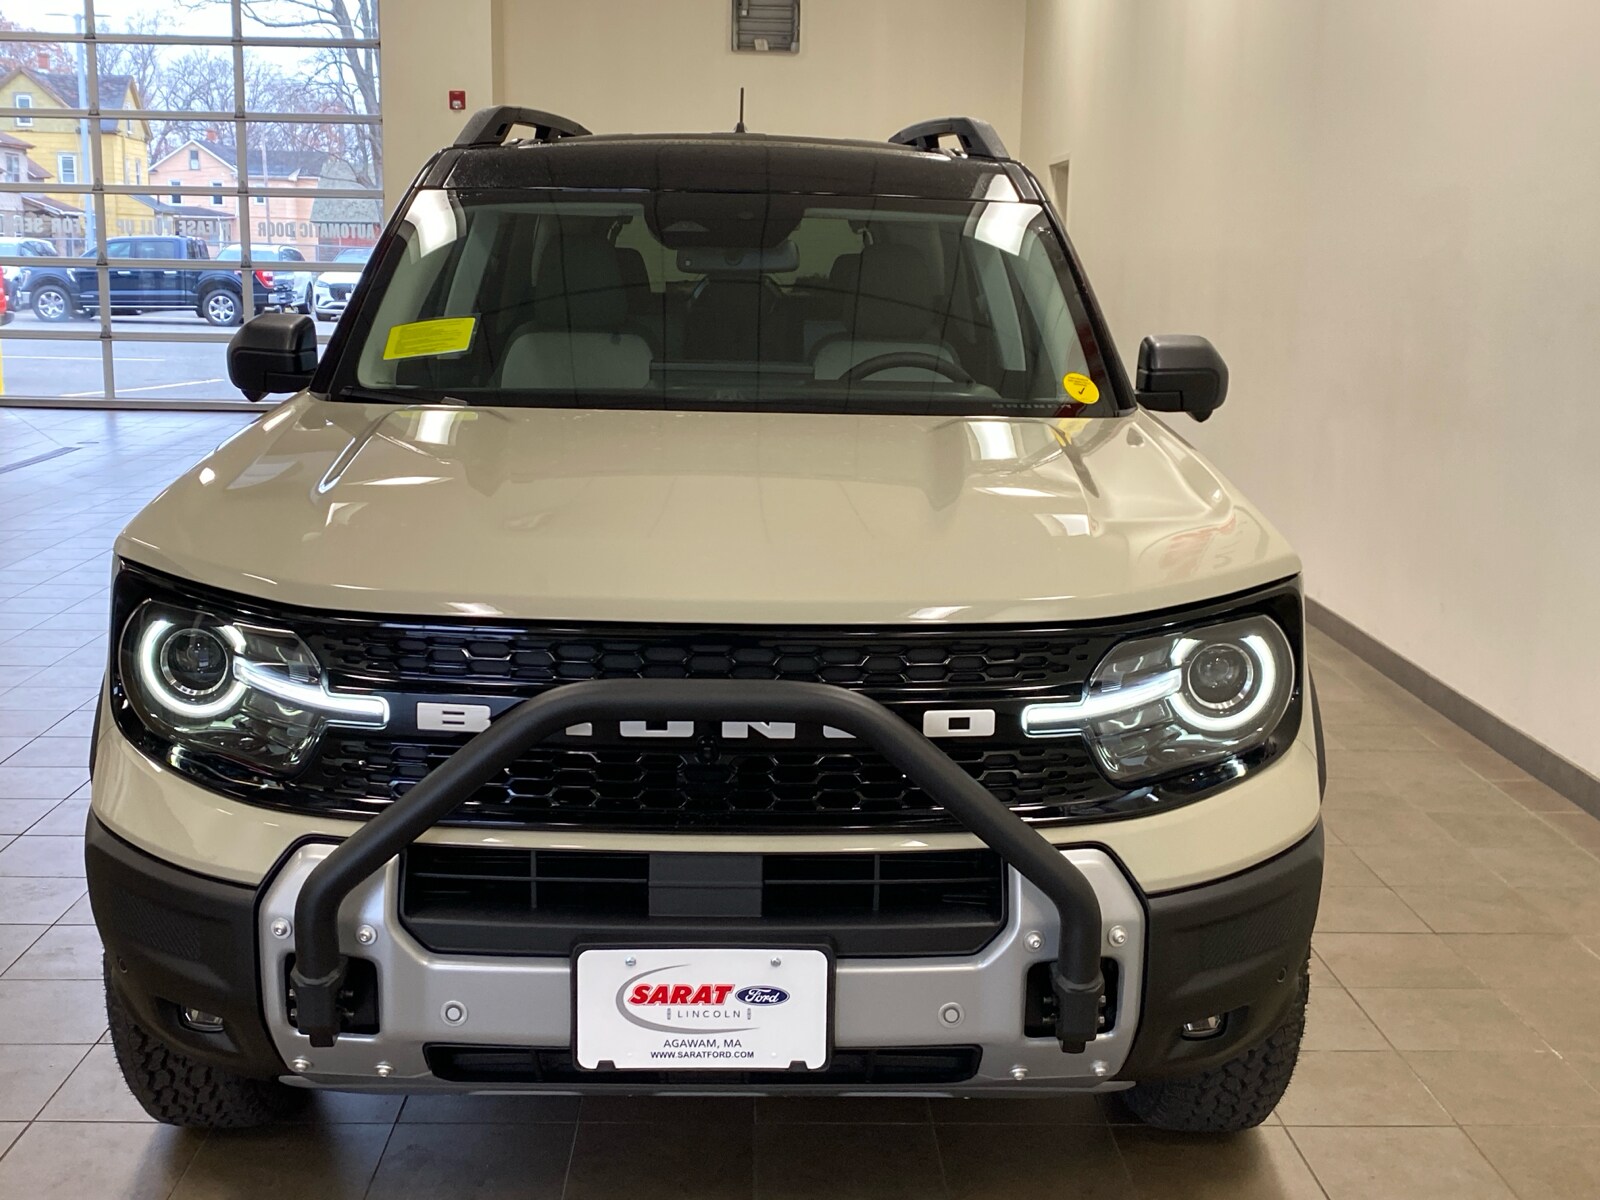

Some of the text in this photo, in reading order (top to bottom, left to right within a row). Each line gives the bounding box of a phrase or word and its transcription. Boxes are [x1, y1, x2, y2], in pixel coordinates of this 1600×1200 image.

[628, 984, 780, 1005] SARAT Ford
[677, 1009, 741, 1019] LINCOLN
[663, 1038, 742, 1050] AGAWAM, MA
[650, 1050, 755, 1059] WWW.SARATFORD.COM
